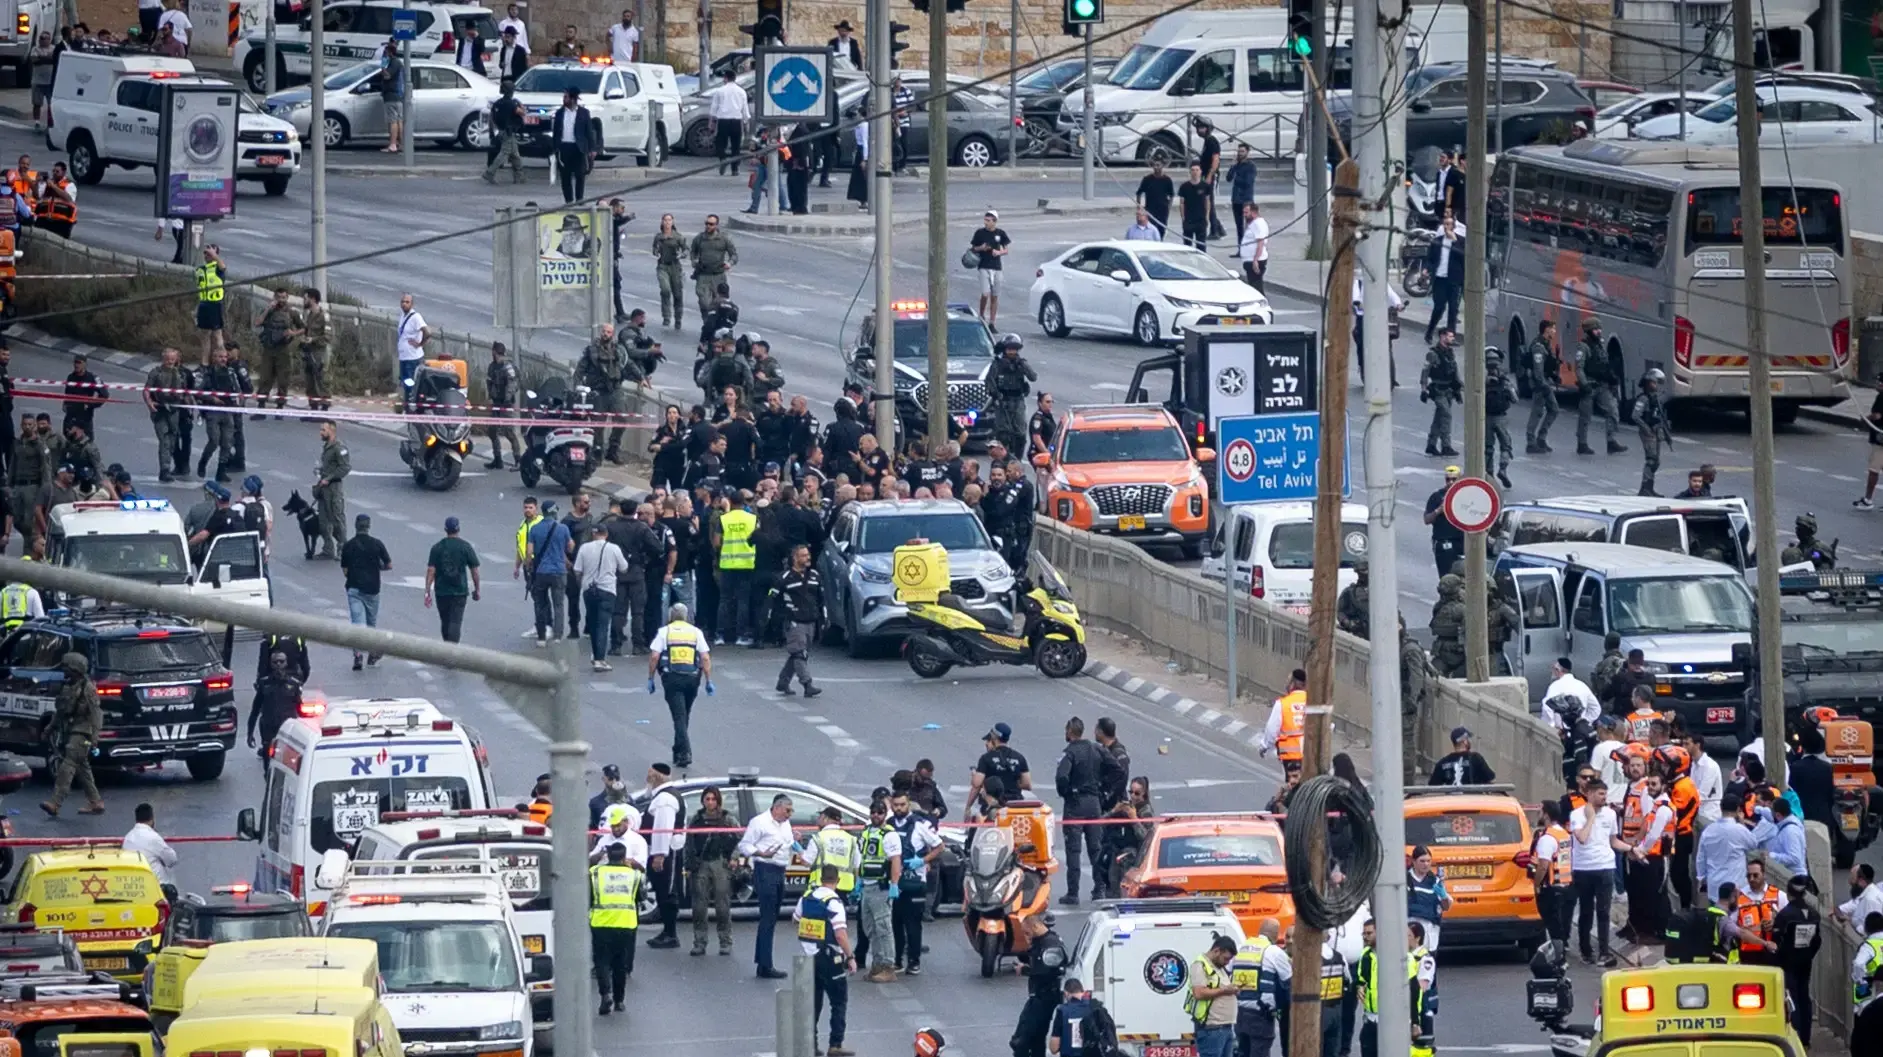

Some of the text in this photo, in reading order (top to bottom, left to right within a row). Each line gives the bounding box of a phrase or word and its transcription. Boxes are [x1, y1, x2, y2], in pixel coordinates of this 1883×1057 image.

[541, 261, 577, 272] המלך
[1272, 373, 1299, 393] לב
[1265, 396, 1303, 408] הבירה
[1254, 424, 1314, 444] תל אביב
[1231, 454, 1250, 468] 4.8
[1263, 447, 1307, 469] تل أبيب
[1258, 471, 1313, 489] Tel Aviv
[1656, 1017, 1727, 1032] פראמדיק
